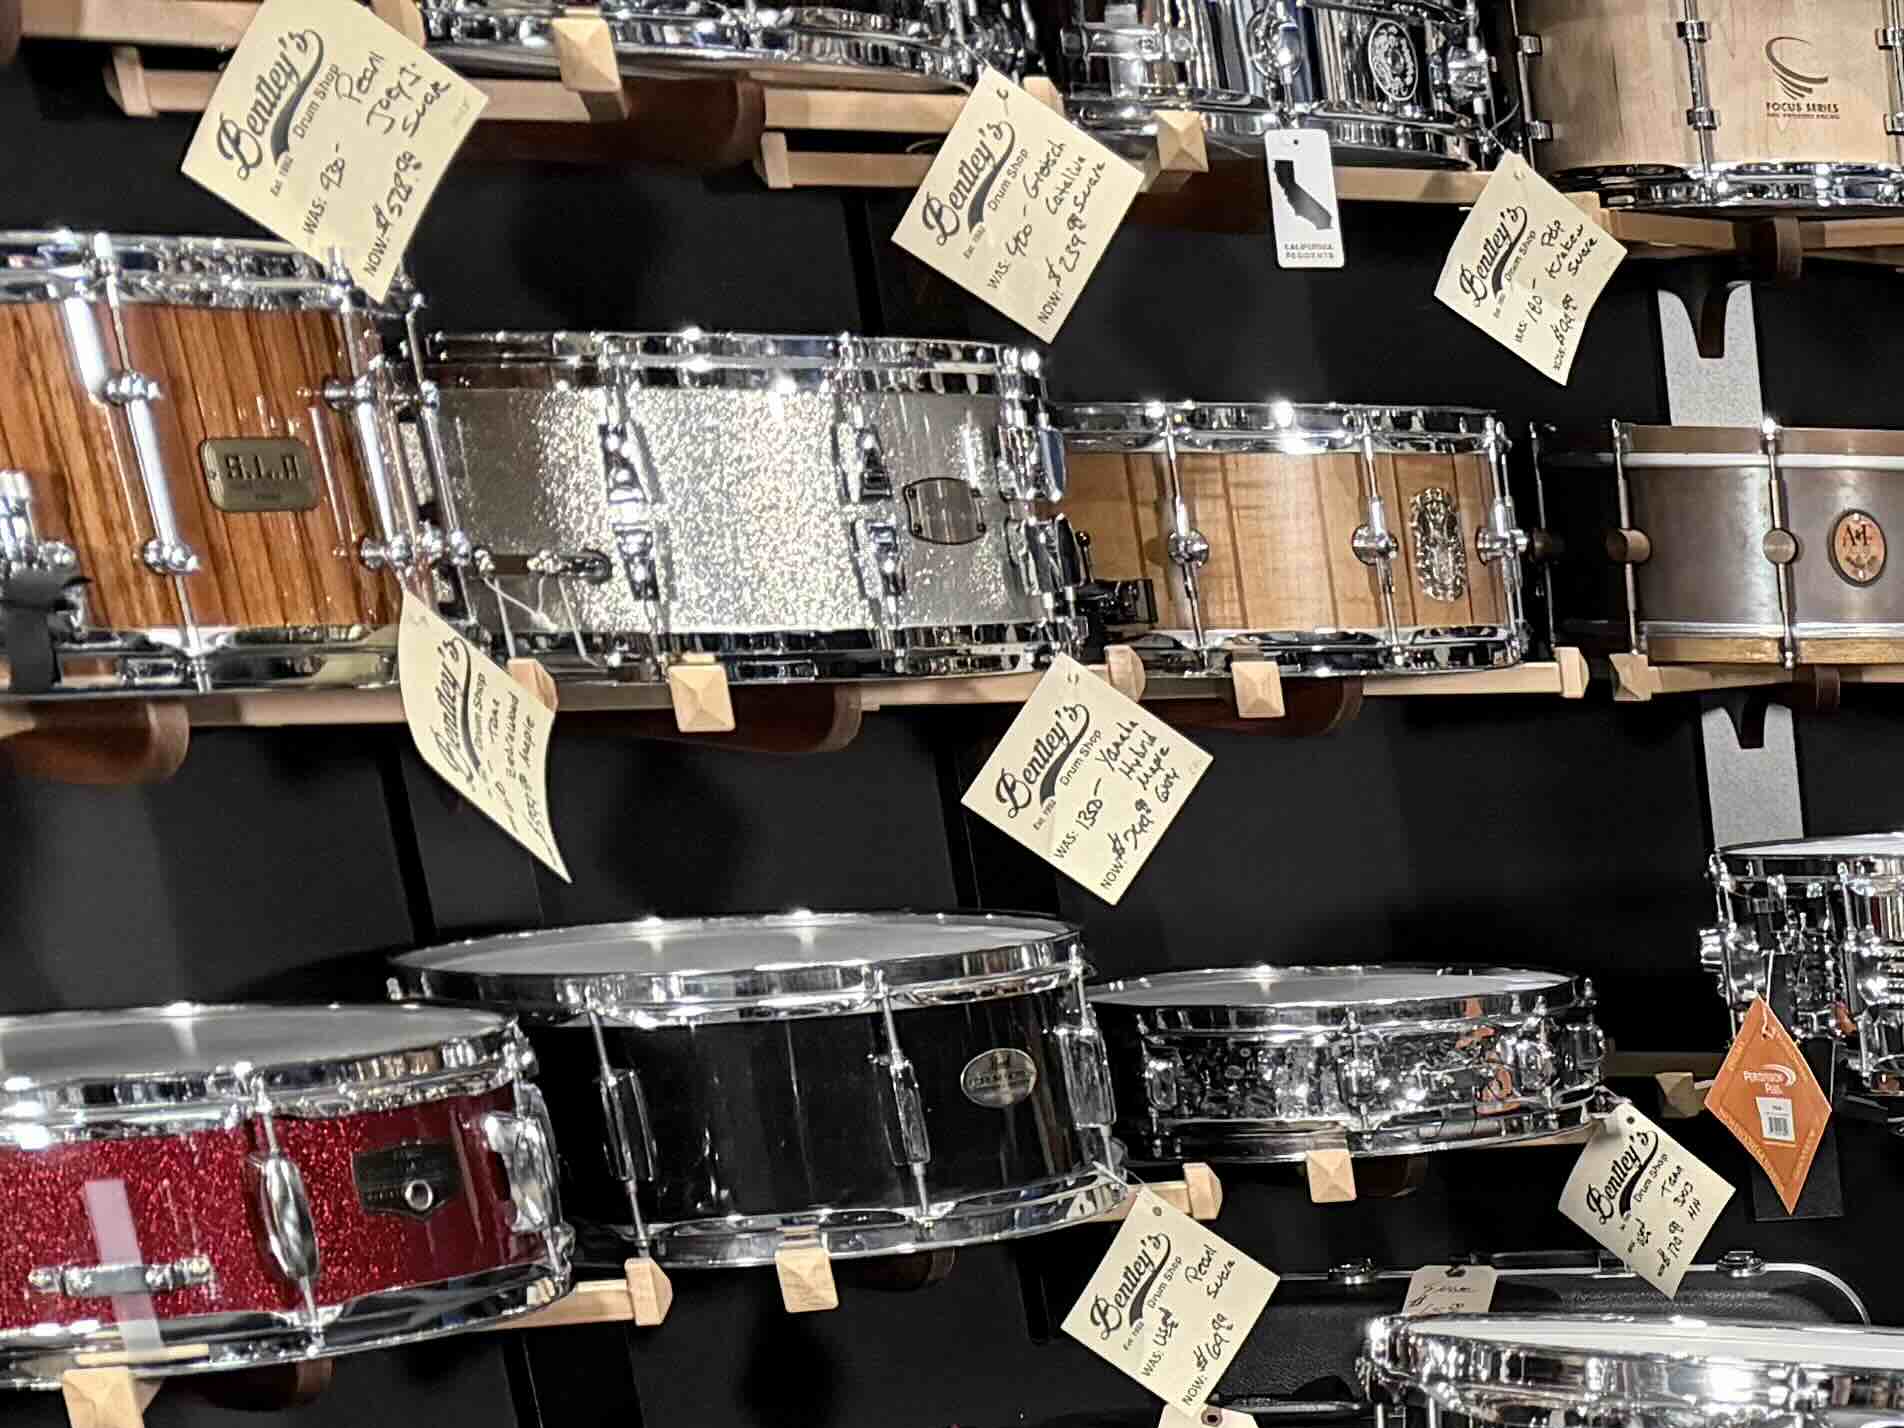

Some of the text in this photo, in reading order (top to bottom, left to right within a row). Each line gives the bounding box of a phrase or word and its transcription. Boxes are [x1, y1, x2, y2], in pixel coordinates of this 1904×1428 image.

[216, 30, 318, 181] Bentley's
[293, 63, 340, 139] Drum Shop
[1766, 102, 1802, 112] FOCUS
[921, 121, 1008, 248] Bentley's
[988, 147, 1029, 212] Drum Shop
[302, 197, 328, 236] WAS:
[1518, 229, 1537, 257] Shop
[986, 260, 1012, 290] WAS:
[1458, 206, 1523, 309] Bentley's
[1036, 290, 1065, 325] NOW:
[995, 703, 1086, 819] Bentley's
[1059, 729, 1103, 787] Drum Shop
[1053, 831, 1080, 860] WAS:
[1586, 1130, 1658, 1226] Bentley's
[1648, 1153, 1669, 1179] Shop
[1089, 1233, 1171, 1341] Bentley's
[1146, 1255, 1184, 1309] Drum Shop
[1140, 1349, 1166, 1379] WAS:
[1181, 1374, 1208, 1407] NOW:
